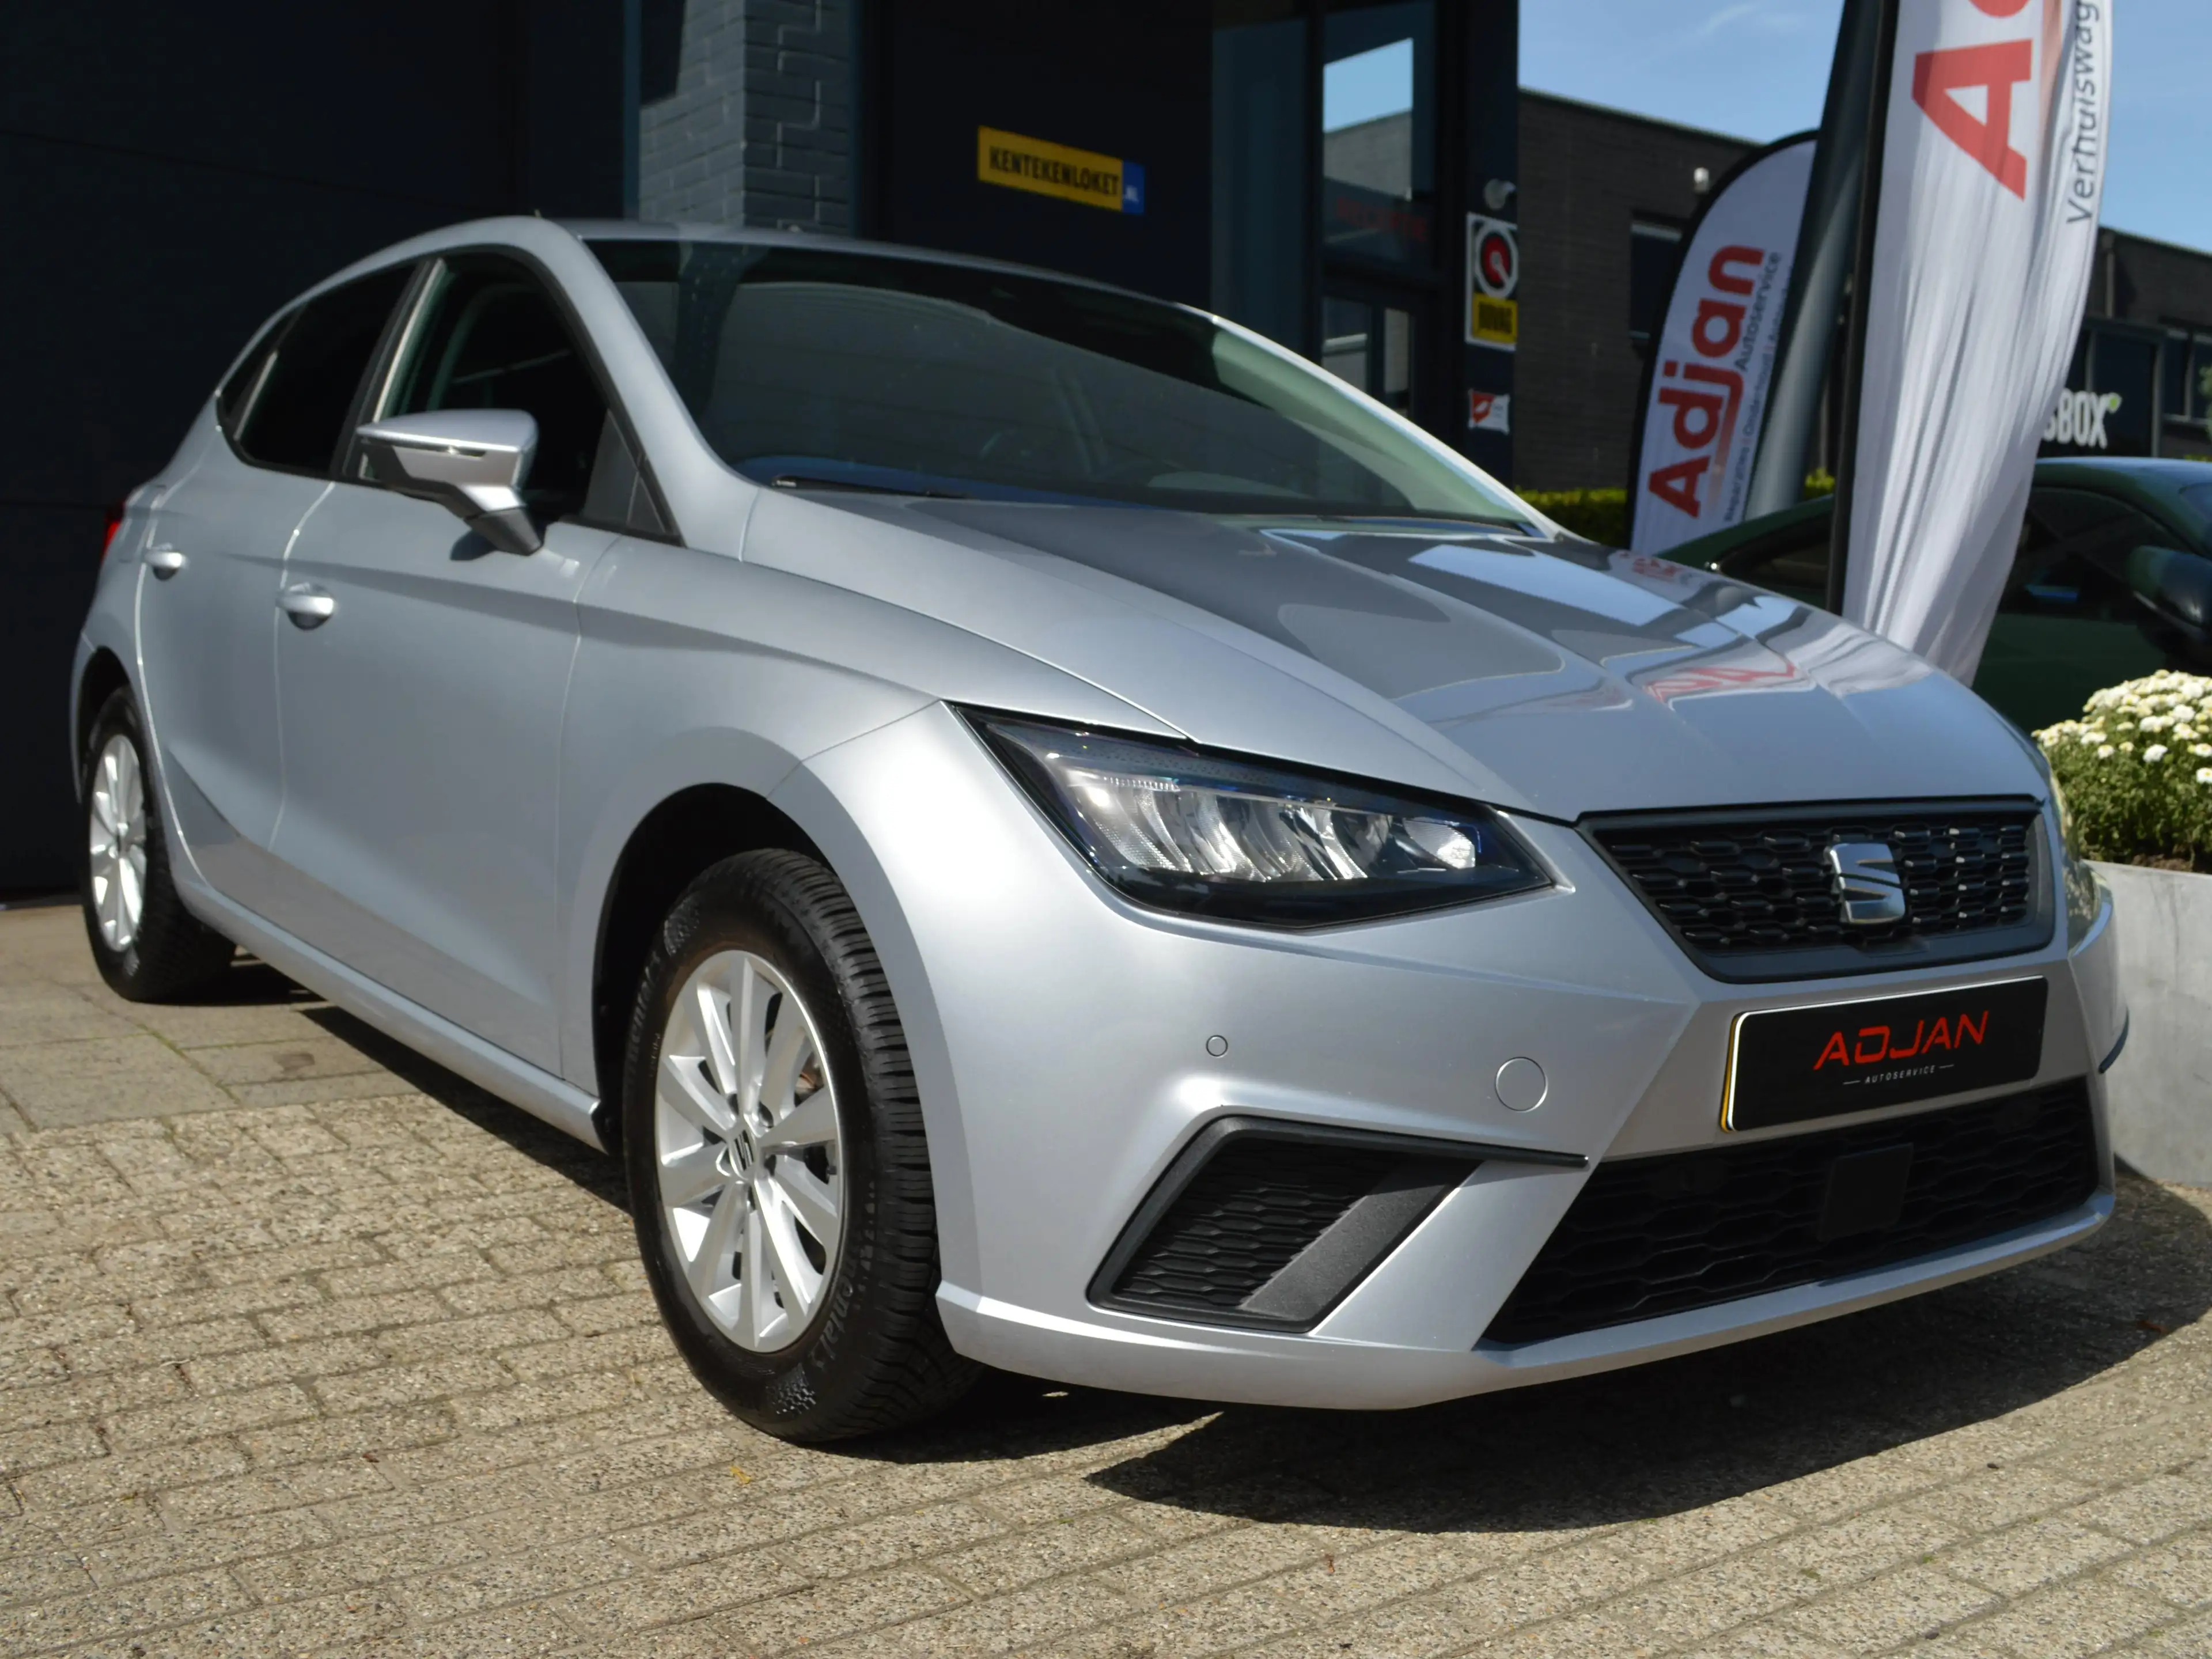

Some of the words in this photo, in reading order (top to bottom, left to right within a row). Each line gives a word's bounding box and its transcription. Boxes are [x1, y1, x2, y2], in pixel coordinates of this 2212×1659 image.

[989, 145, 1119, 197] KENTEKENLOKET
[1734, 252, 1781, 372] Autoservice
[1648, 244, 1765, 519] Adjan
[1813, 1010, 1989, 1070] ADJAN
[1864, 1065, 1936, 1084] AUTOSERVICE
